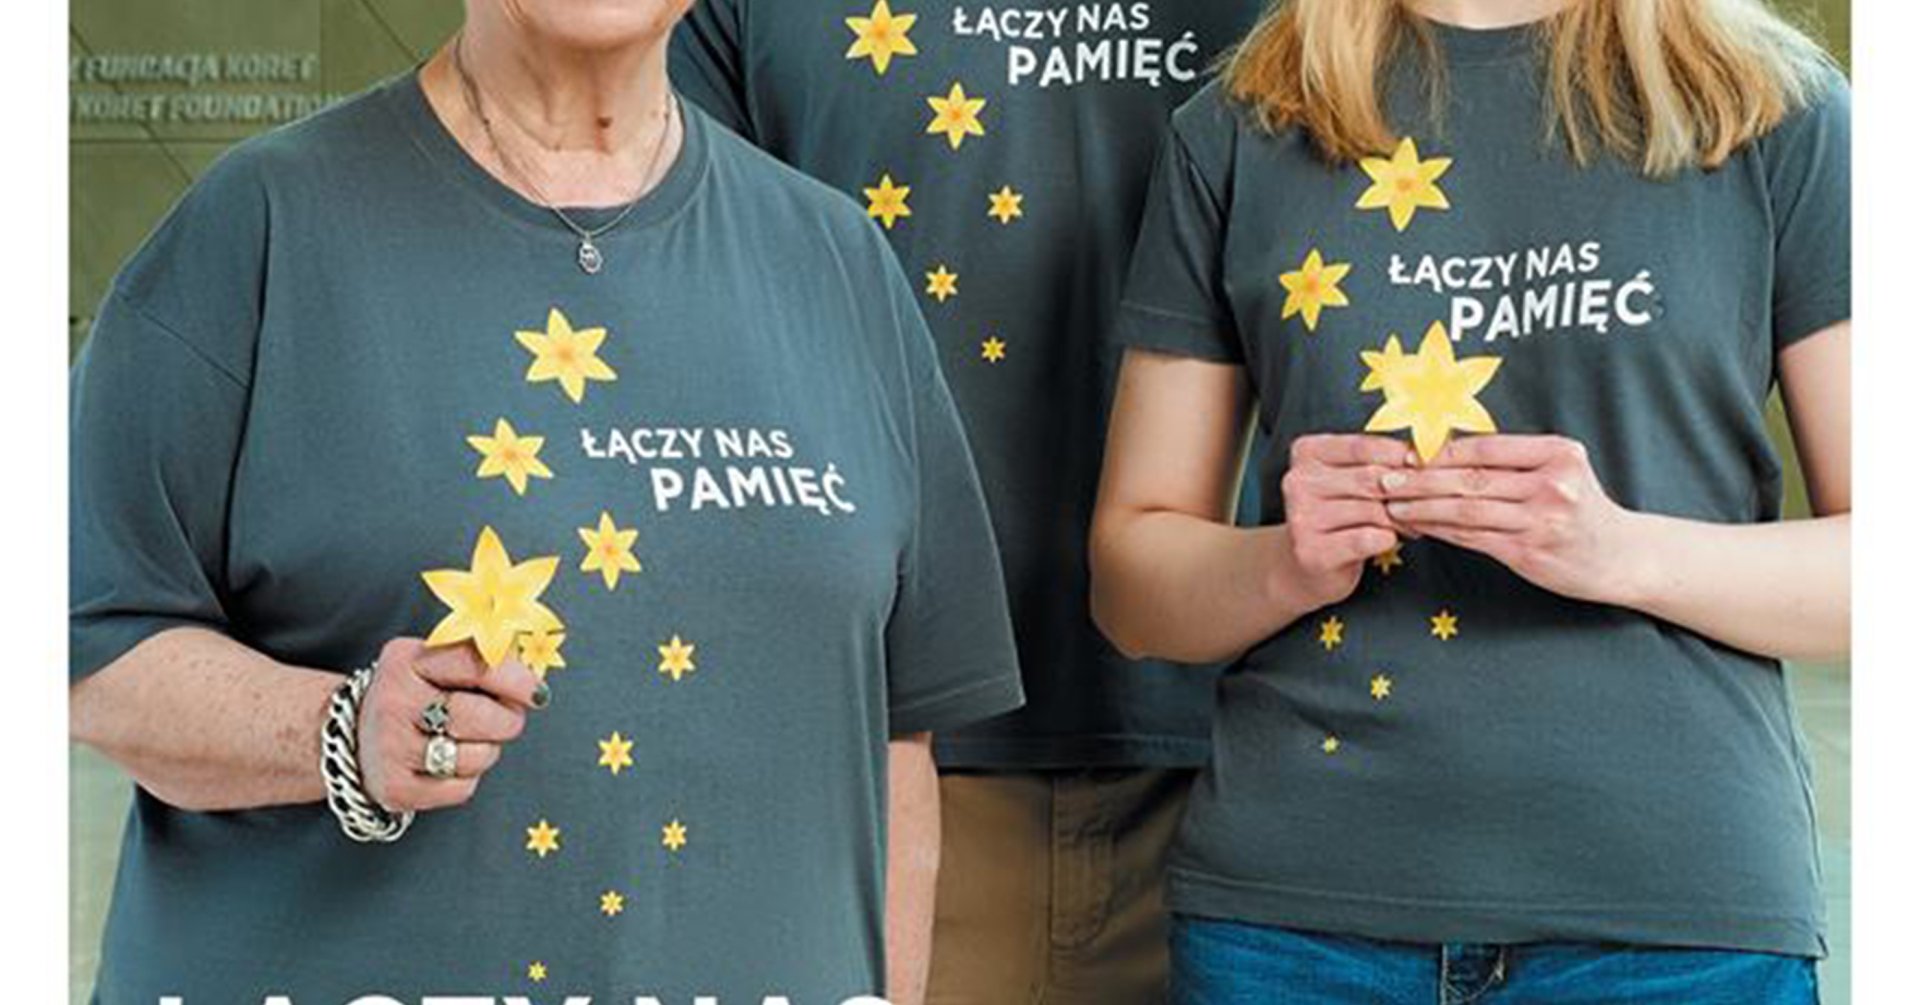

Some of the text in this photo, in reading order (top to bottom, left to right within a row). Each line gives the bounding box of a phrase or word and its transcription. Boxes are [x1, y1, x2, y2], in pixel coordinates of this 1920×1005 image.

[952, 2, 1150, 41] ŁĄCZY NAS
[1008, 31, 1198, 87] PAMIĘĆ
[1387, 241, 1600, 292] ŁĄCZY NAS
[1450, 269, 1655, 342] PAMIĘĆ
[580, 427, 794, 464] ŁĄCZY NAS
[650, 462, 857, 516] PAMIĘĆ
